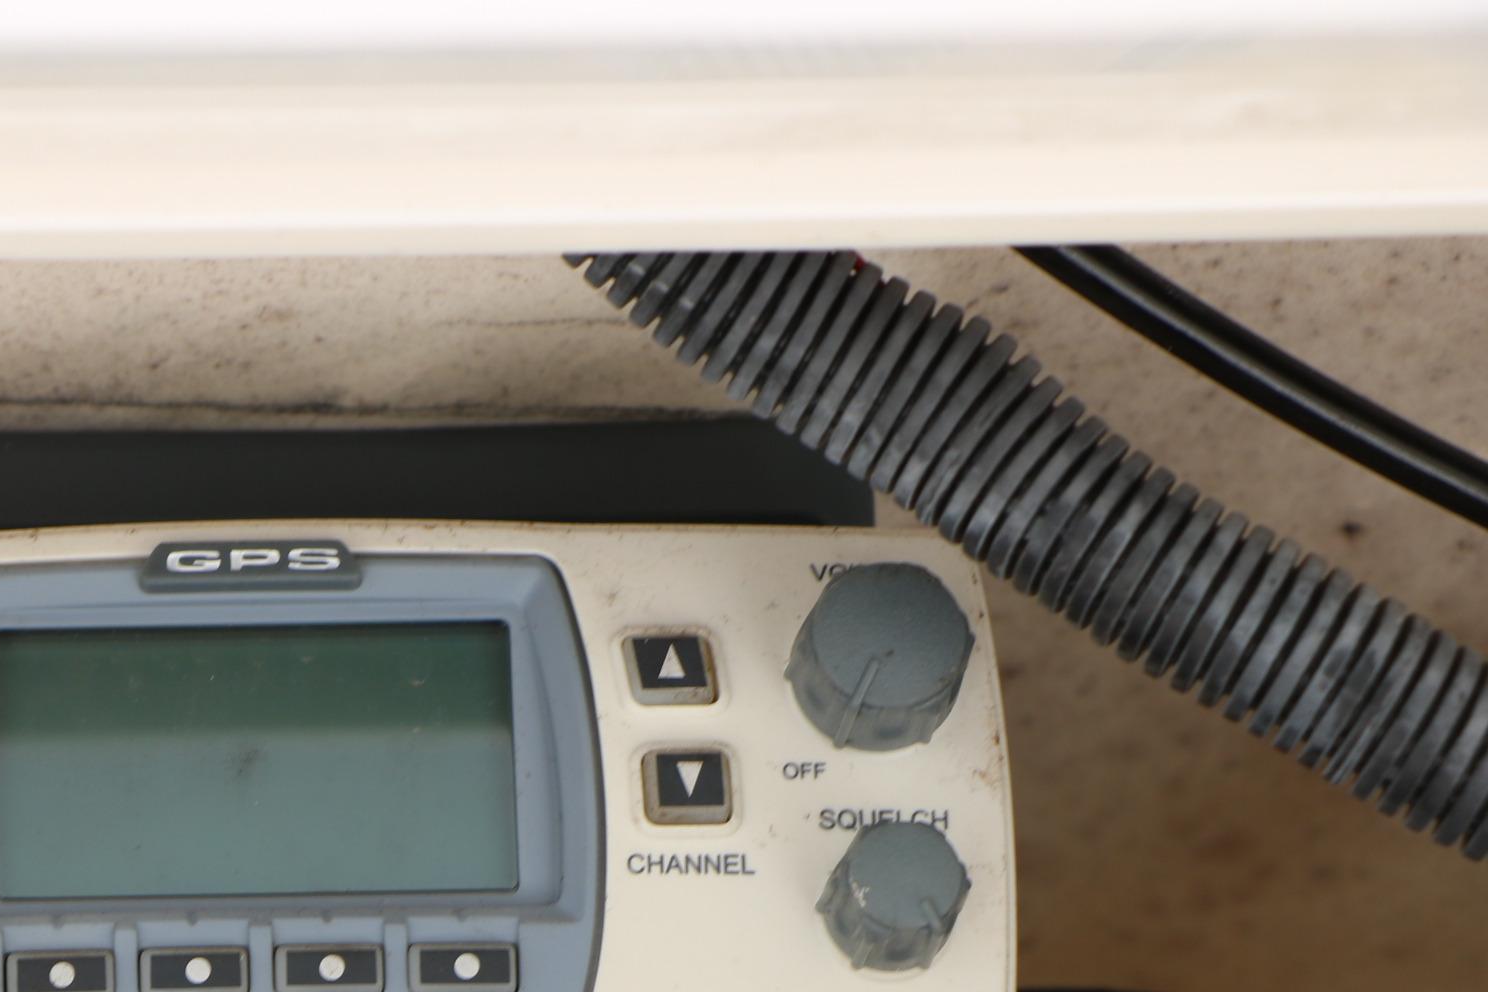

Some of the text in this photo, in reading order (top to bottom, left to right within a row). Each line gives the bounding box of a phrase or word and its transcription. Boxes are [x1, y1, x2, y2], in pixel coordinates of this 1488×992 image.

[166, 547, 341, 573] GPS
[782, 761, 826, 781] OFF
[626, 853, 755, 875] CHANNEL
